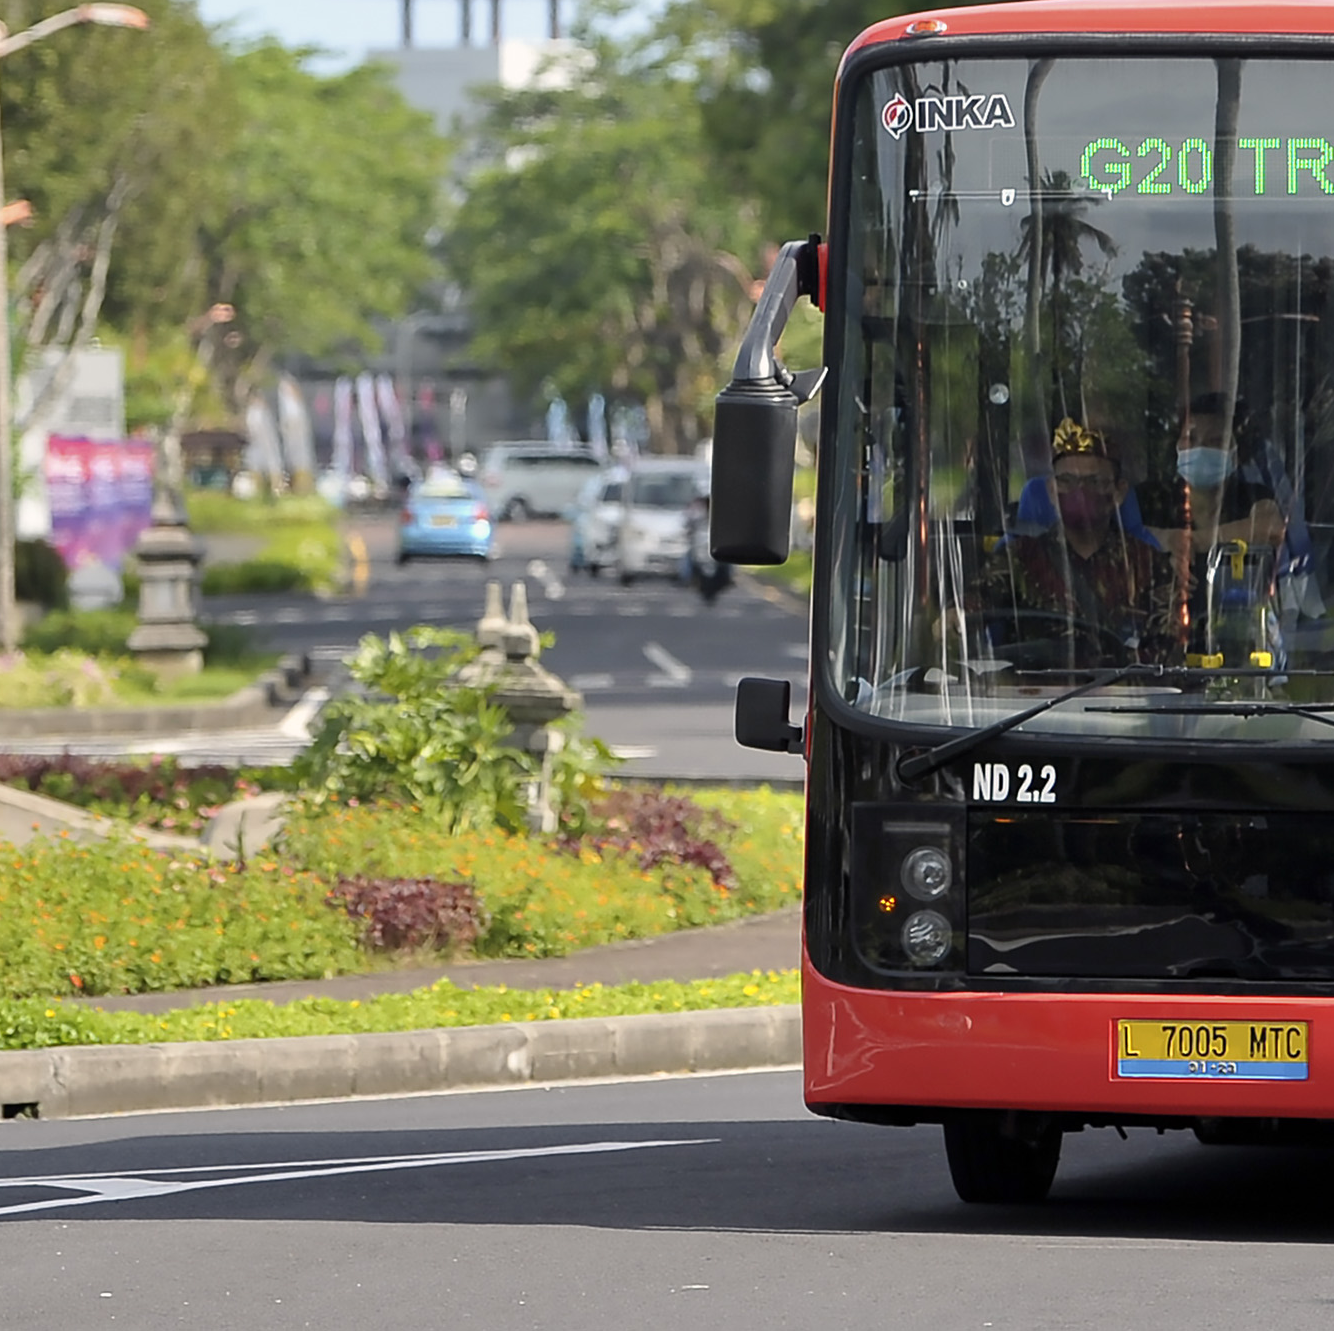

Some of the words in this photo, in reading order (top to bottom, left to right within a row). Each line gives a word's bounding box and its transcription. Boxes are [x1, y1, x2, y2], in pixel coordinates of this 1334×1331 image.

[916, 94, 1015, 132] INKA
[1081, 138, 1212, 193] G20
[973, 763, 1009, 801] ND
[1017, 764, 1056, 802] 2.2
[1124, 1025, 1139, 1057] L
[1162, 1025, 1228, 1058] 7005
[1250, 1026, 1301, 1059] MTC
